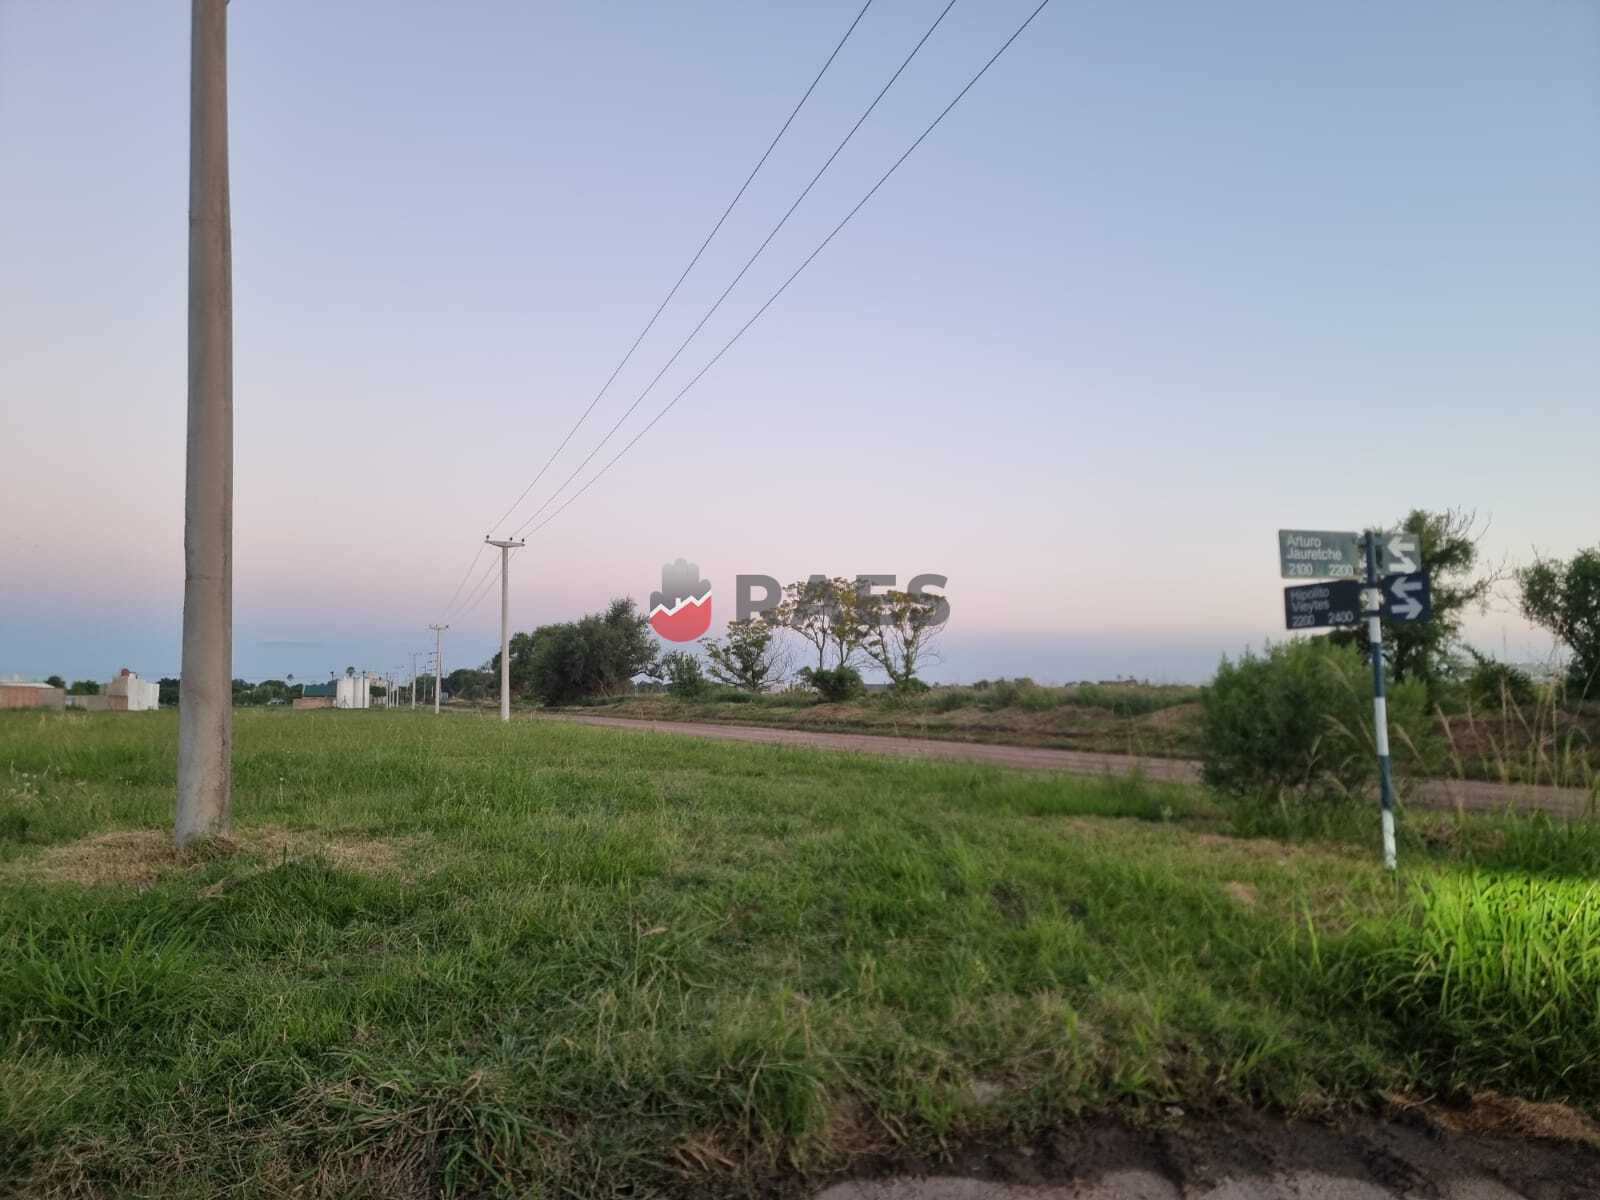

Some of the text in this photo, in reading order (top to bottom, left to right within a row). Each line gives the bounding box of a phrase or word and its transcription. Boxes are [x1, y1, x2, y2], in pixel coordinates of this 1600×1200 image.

[1287, 535, 1321, 547] Arturo
[1287, 548, 1342, 560] Jauretche
[1328, 564, 1354, 576] 2200
